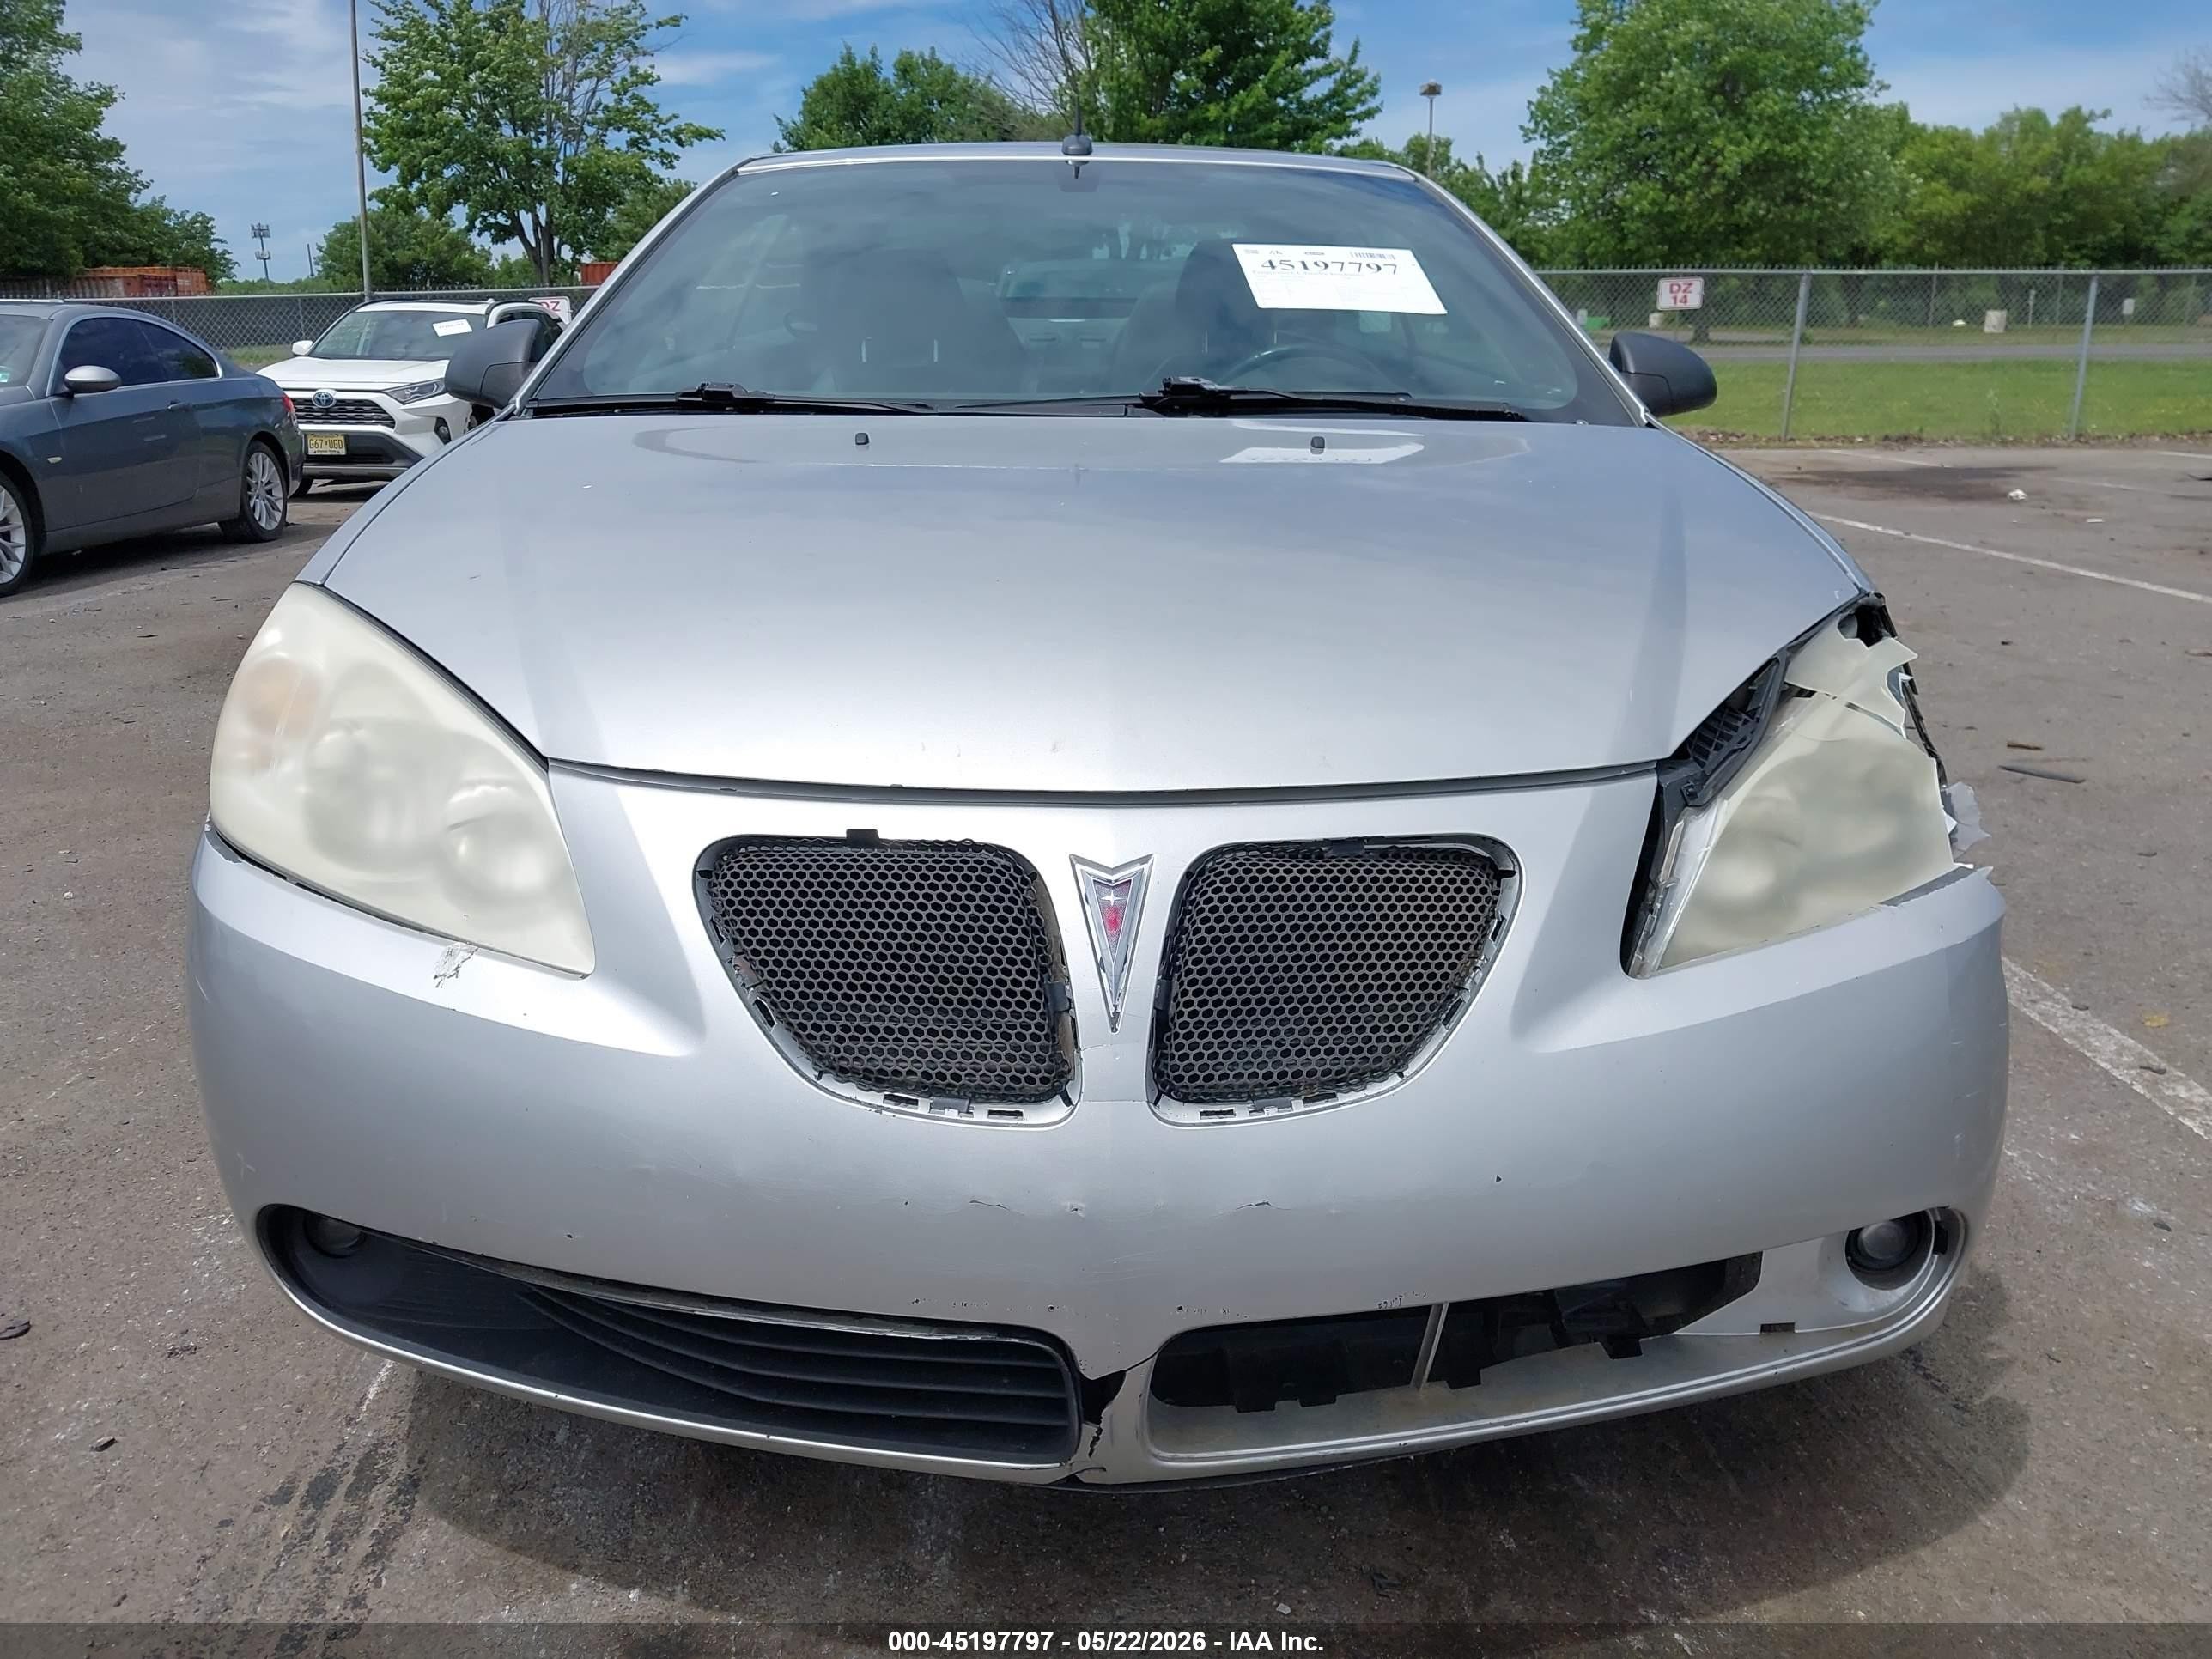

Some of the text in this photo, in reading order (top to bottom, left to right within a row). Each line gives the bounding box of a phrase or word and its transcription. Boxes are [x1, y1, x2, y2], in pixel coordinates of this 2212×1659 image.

[1261, 259, 1397, 275] 45197797
[1669, 283, 1692, 294] DZ
[1671, 295, 1688, 305] 14
